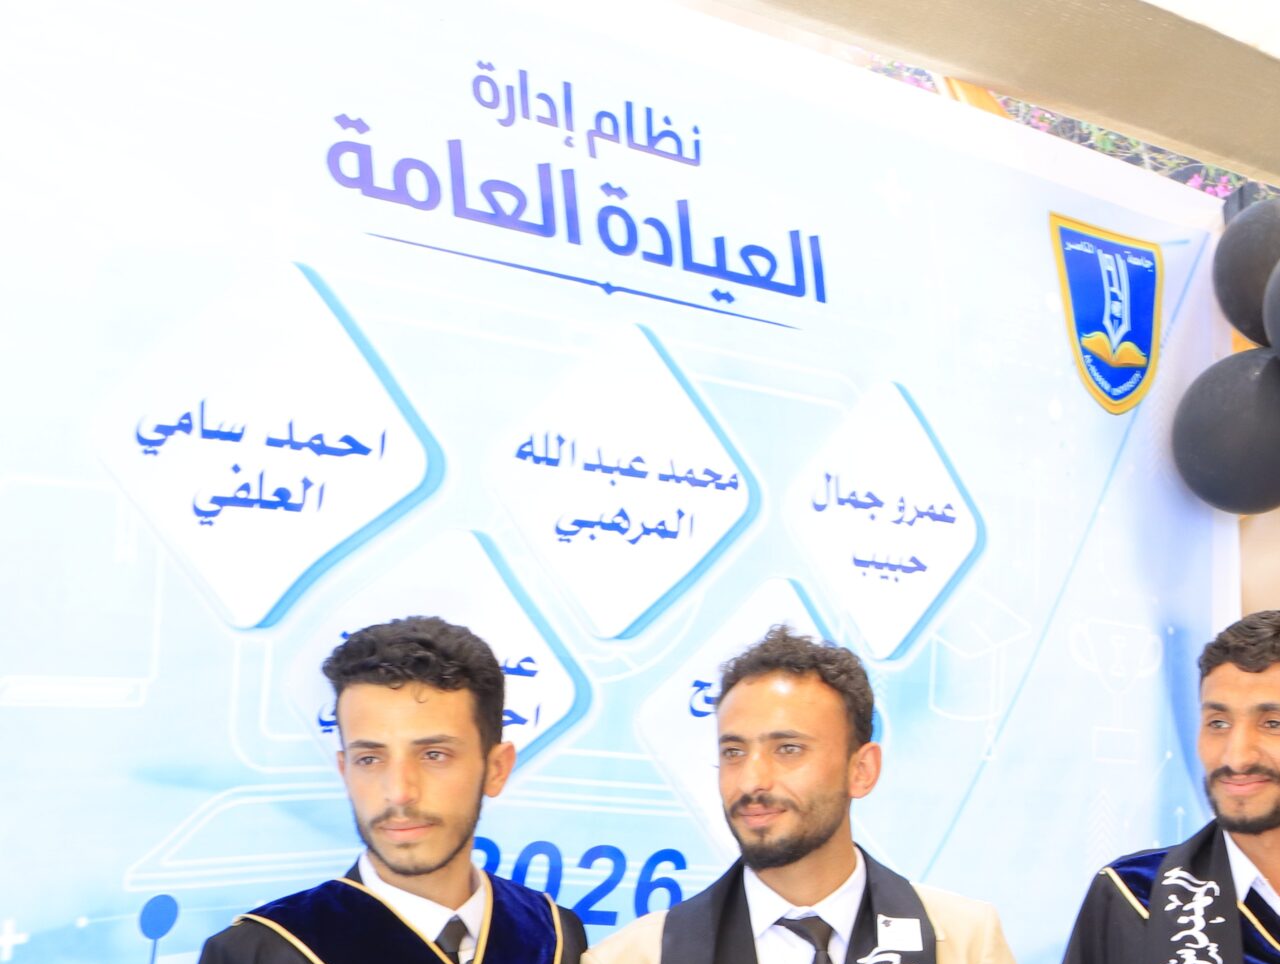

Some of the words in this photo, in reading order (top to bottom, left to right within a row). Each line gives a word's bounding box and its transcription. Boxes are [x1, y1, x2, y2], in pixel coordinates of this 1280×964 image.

[472, 60, 575, 148] إدارة
[586, 100, 700, 167] نظام
[327, 113, 582, 246] العامة
[599, 181, 827, 303] العيادة
[135, 398, 246, 456] سامي
[265, 418, 386, 460] احمد
[515, 430, 575, 467] الله
[583, 447, 650, 486] عبد
[658, 458, 739, 490] محمد
[192, 463, 325, 526] العلفي
[812, 472, 885, 520] جمال
[890, 496, 956, 526] عمرو
[555, 507, 694, 545] المرهبي
[853, 552, 928, 582] حبيب
